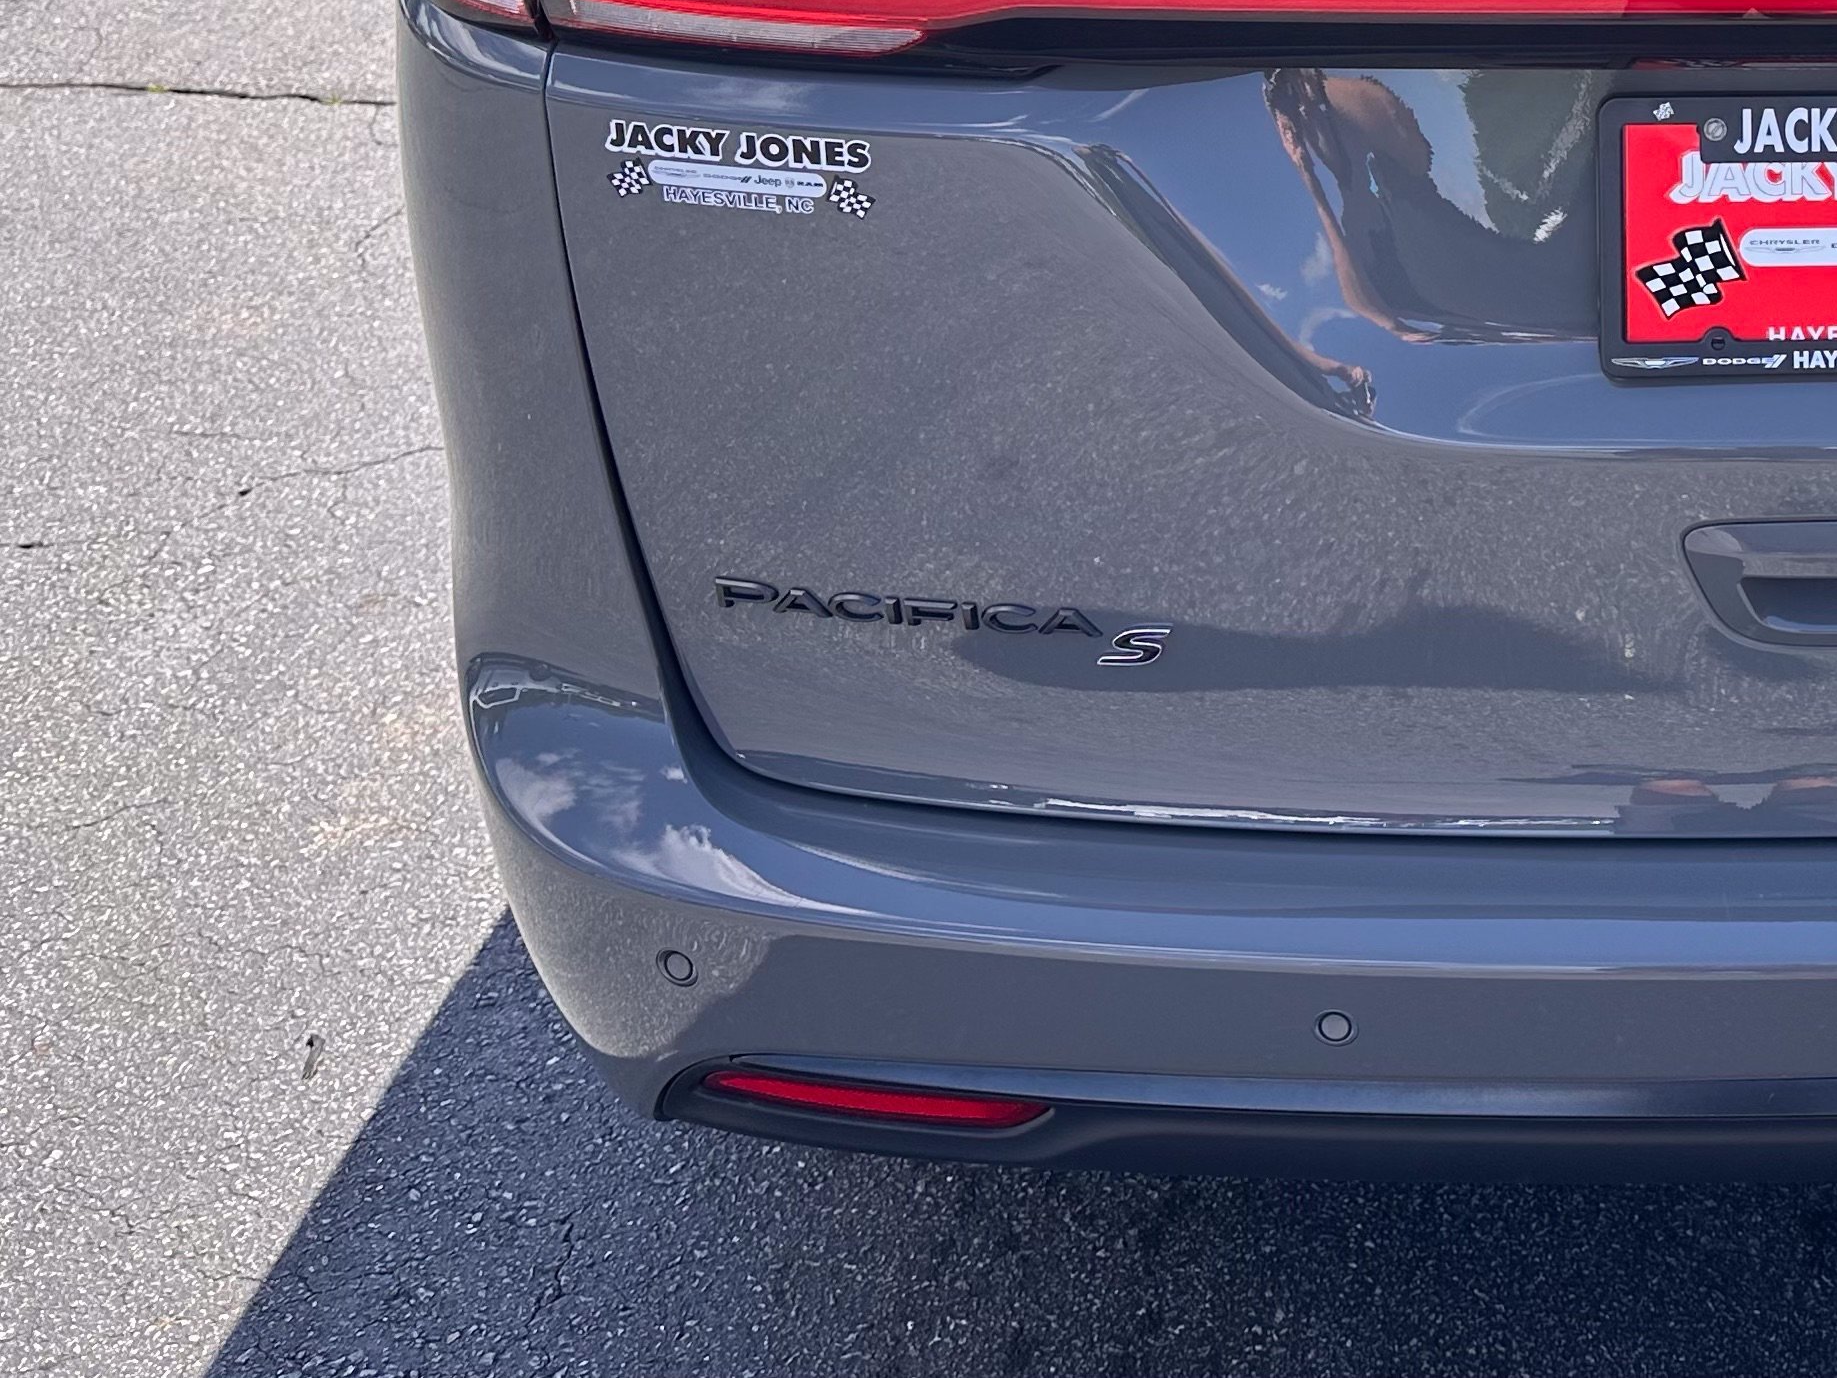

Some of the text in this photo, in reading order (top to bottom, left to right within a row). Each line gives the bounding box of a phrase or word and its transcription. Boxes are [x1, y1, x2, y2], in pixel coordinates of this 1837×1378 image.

[607, 120, 871, 171] JACKY JONES
[754, 175, 782, 187] Jeep
[663, 186, 815, 214] HAYESVILLE, NC
[1749, 238, 1821, 246] CHRYSLER
[1702, 357, 1774, 366] DODGE
[714, 576, 1174, 667] PACIFICA S
